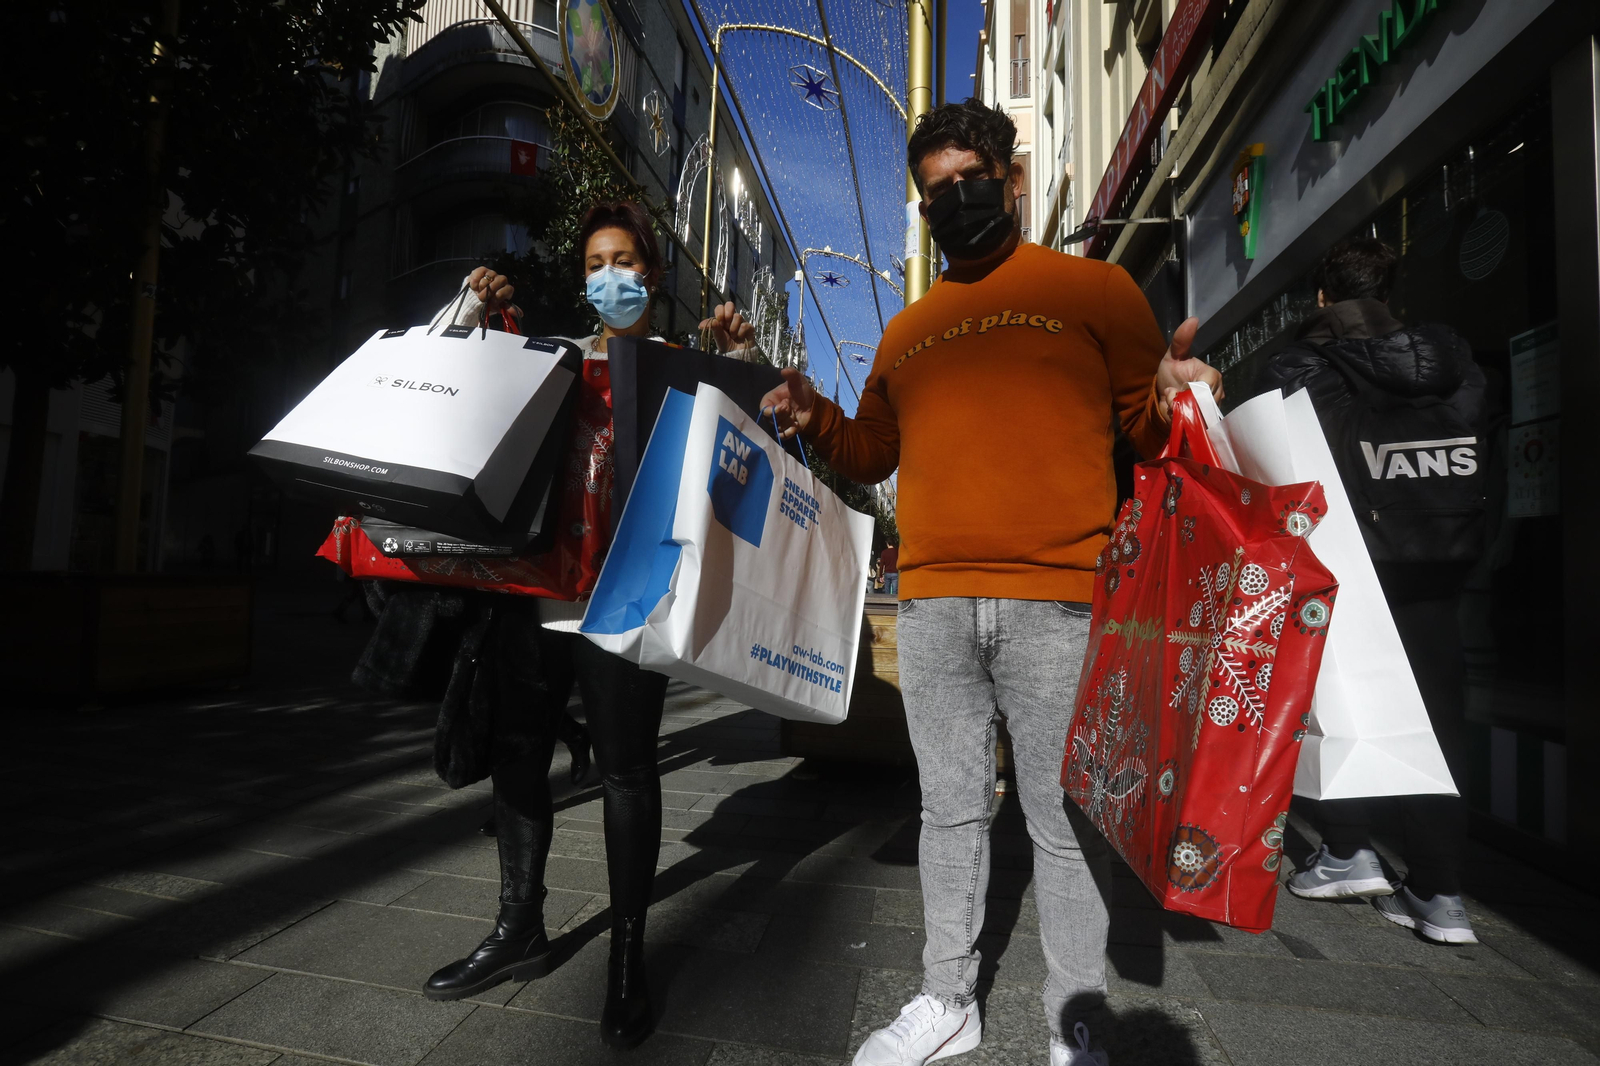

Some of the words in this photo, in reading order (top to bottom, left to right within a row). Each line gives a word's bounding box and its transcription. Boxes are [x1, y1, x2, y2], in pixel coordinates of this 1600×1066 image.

[1303, 0, 1439, 142] TIEND
[893, 334, 936, 369] out
[942, 317, 973, 340] of
[977, 309, 1064, 334] place
[391, 379, 460, 397] SILBON
[722, 430, 752, 462] AW
[1360, 437, 1478, 480] VANS
[323, 456, 389, 475] SILBONSHOP.COM
[718, 448, 749, 486] LAB
[782, 489, 819, 525] APPAREL.
[784, 477, 822, 514] SNEAKER.
[780, 501, 808, 530] STORE.
[750, 643, 843, 693] #PLAYWITHSTYLE
[793, 644, 845, 676] aw-lab.com
